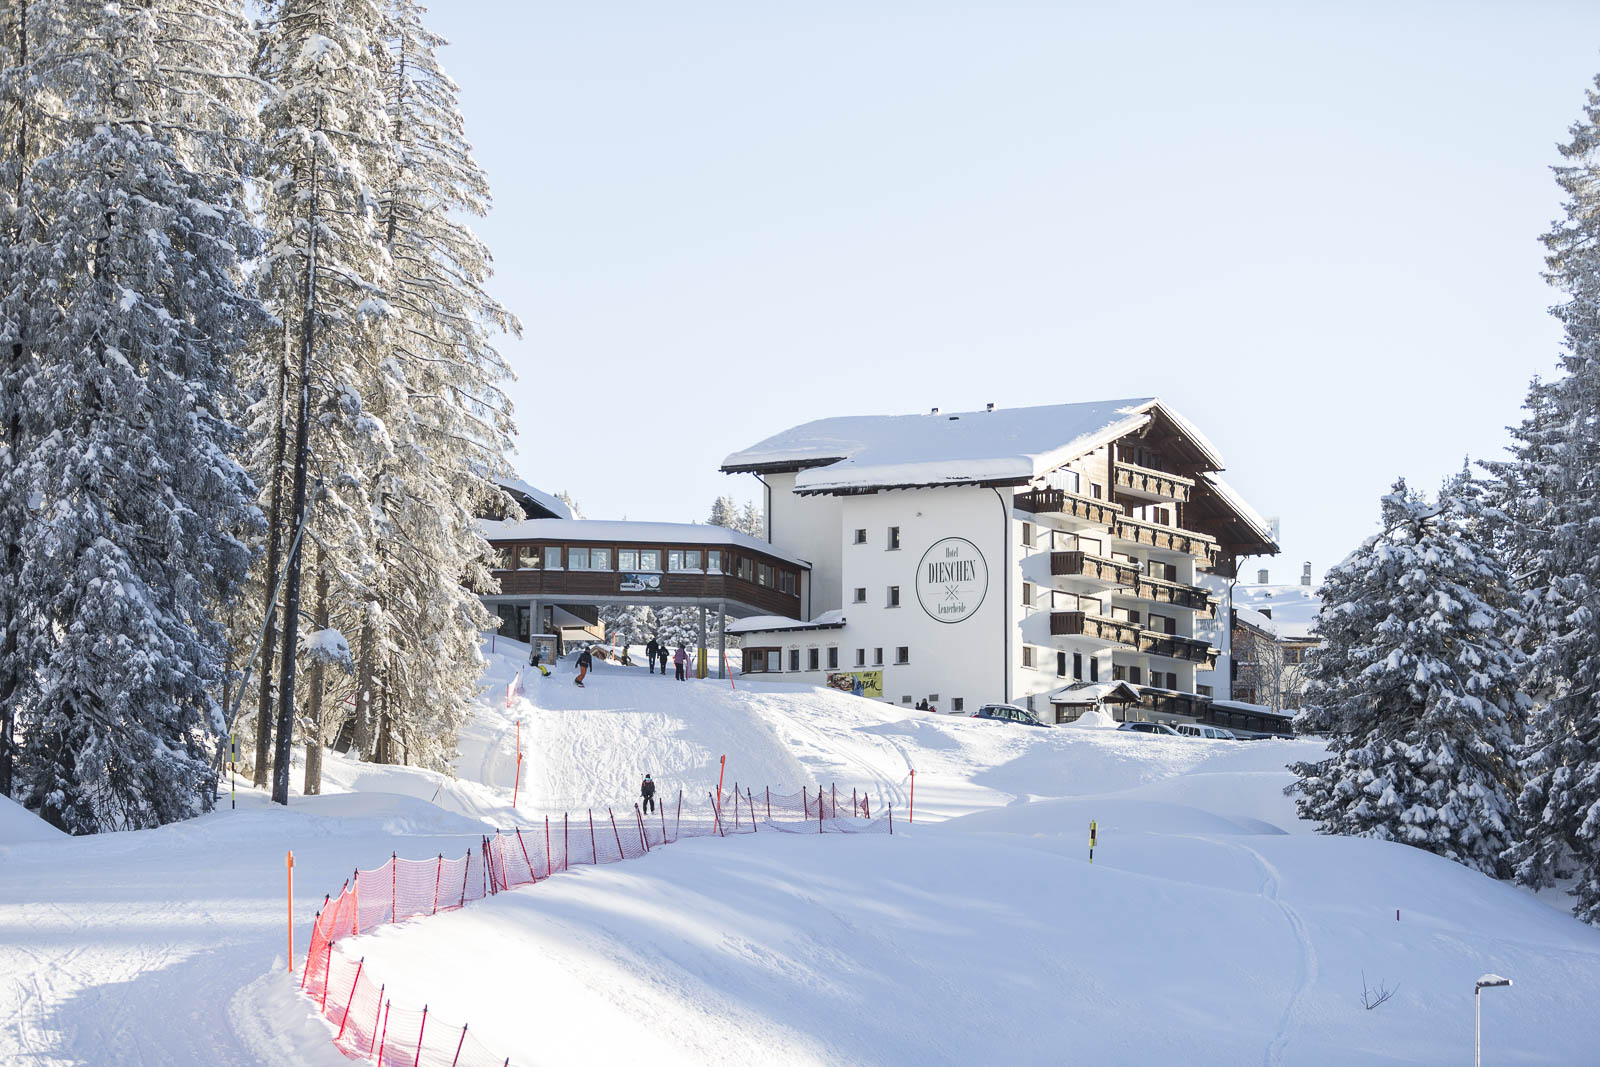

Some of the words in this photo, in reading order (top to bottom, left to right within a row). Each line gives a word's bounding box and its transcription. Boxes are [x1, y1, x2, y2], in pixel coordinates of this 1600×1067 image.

[945, 547, 959, 558] Hotel
[928, 559, 976, 584] DIESCHEN
[857, 679, 882, 691] BREAK
